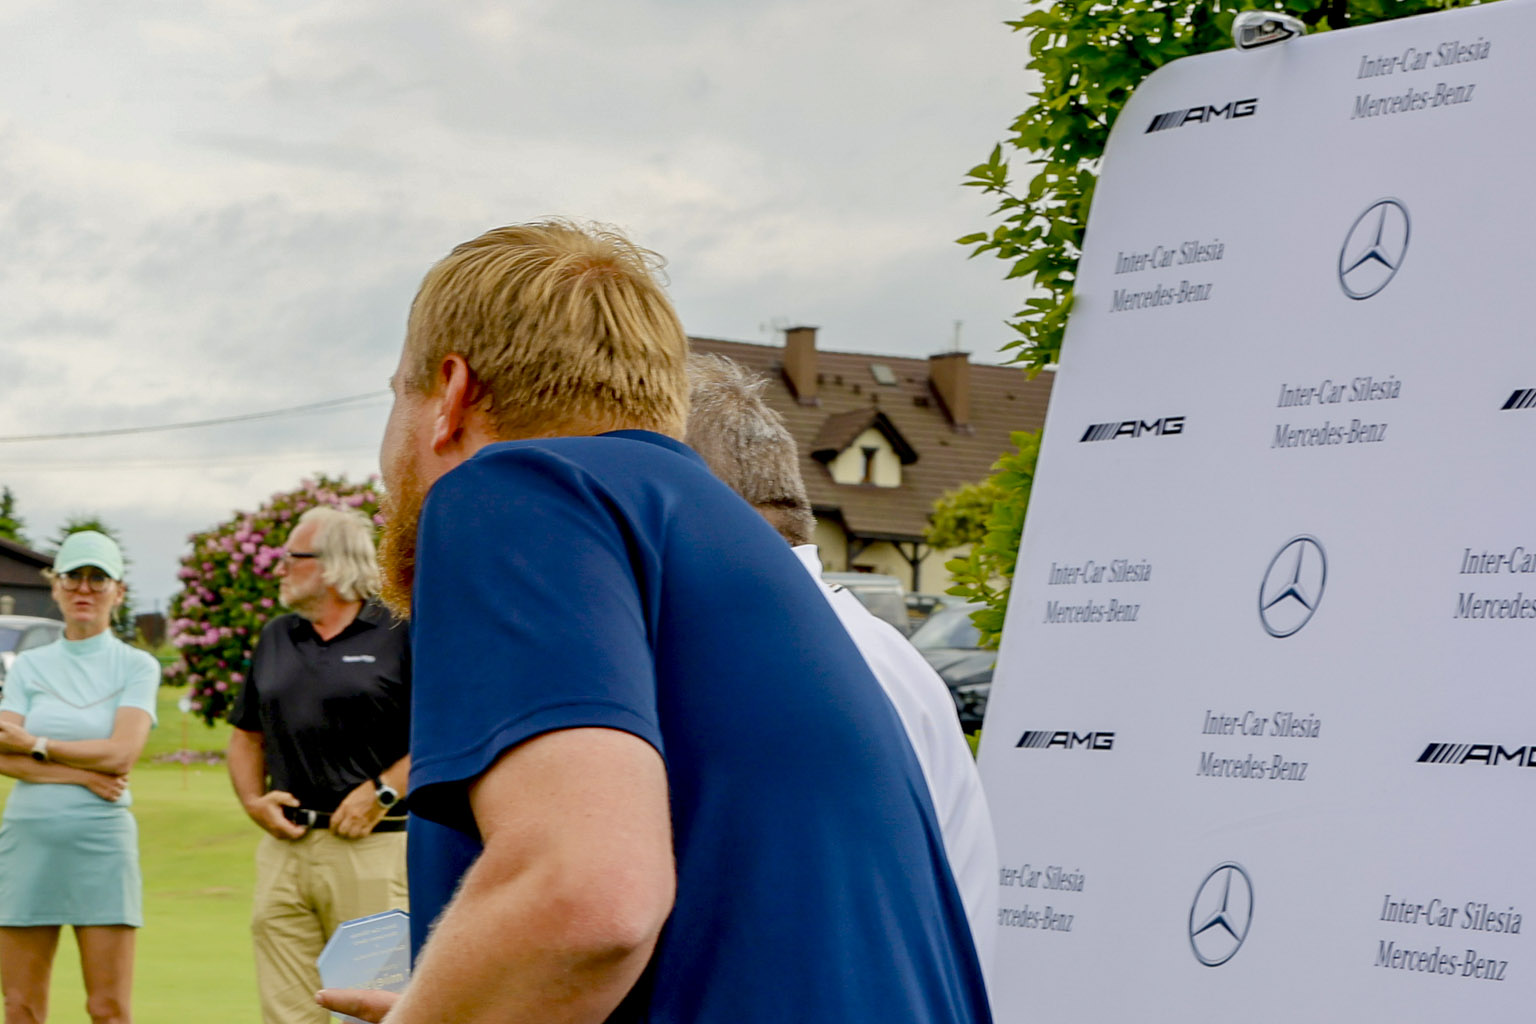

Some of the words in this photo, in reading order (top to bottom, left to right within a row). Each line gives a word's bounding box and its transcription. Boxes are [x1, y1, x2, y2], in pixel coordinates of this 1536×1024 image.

[1357, 47, 1434, 81] Inter-Car
[1435, 37, 1491, 69] Silesia
[1182, 97, 1260, 124] AMG
[1351, 83, 1476, 120] Mercedes-Benz
[1115, 245, 1177, 275] Inter-Car
[1177, 238, 1225, 267] Silesia
[1109, 280, 1213, 312] Mercedes-Benz
[1276, 380, 1347, 409] Inter-Car
[1348, 375, 1402, 403] Silesia
[1114, 416, 1187, 440] AMG
[1270, 419, 1389, 449] Mercedes-Benz
[1047, 560, 1107, 586] Inter-Car
[1107, 559, 1152, 584] Silesia
[1043, 599, 1141, 625] Mercedes-Benz
[1202, 709, 1268, 737] Inter-Car
[1270, 712, 1322, 739] Silesia
[1046, 730, 1116, 751] AMG
[1196, 752, 1308, 782] Mercedes-Benz
[1043, 865, 1085, 892] Silesia
[1379, 895, 1459, 928] Inter-Car
[1460, 902, 1523, 936] Silesia
[1374, 940, 1509, 981] Mercedes-Benz
